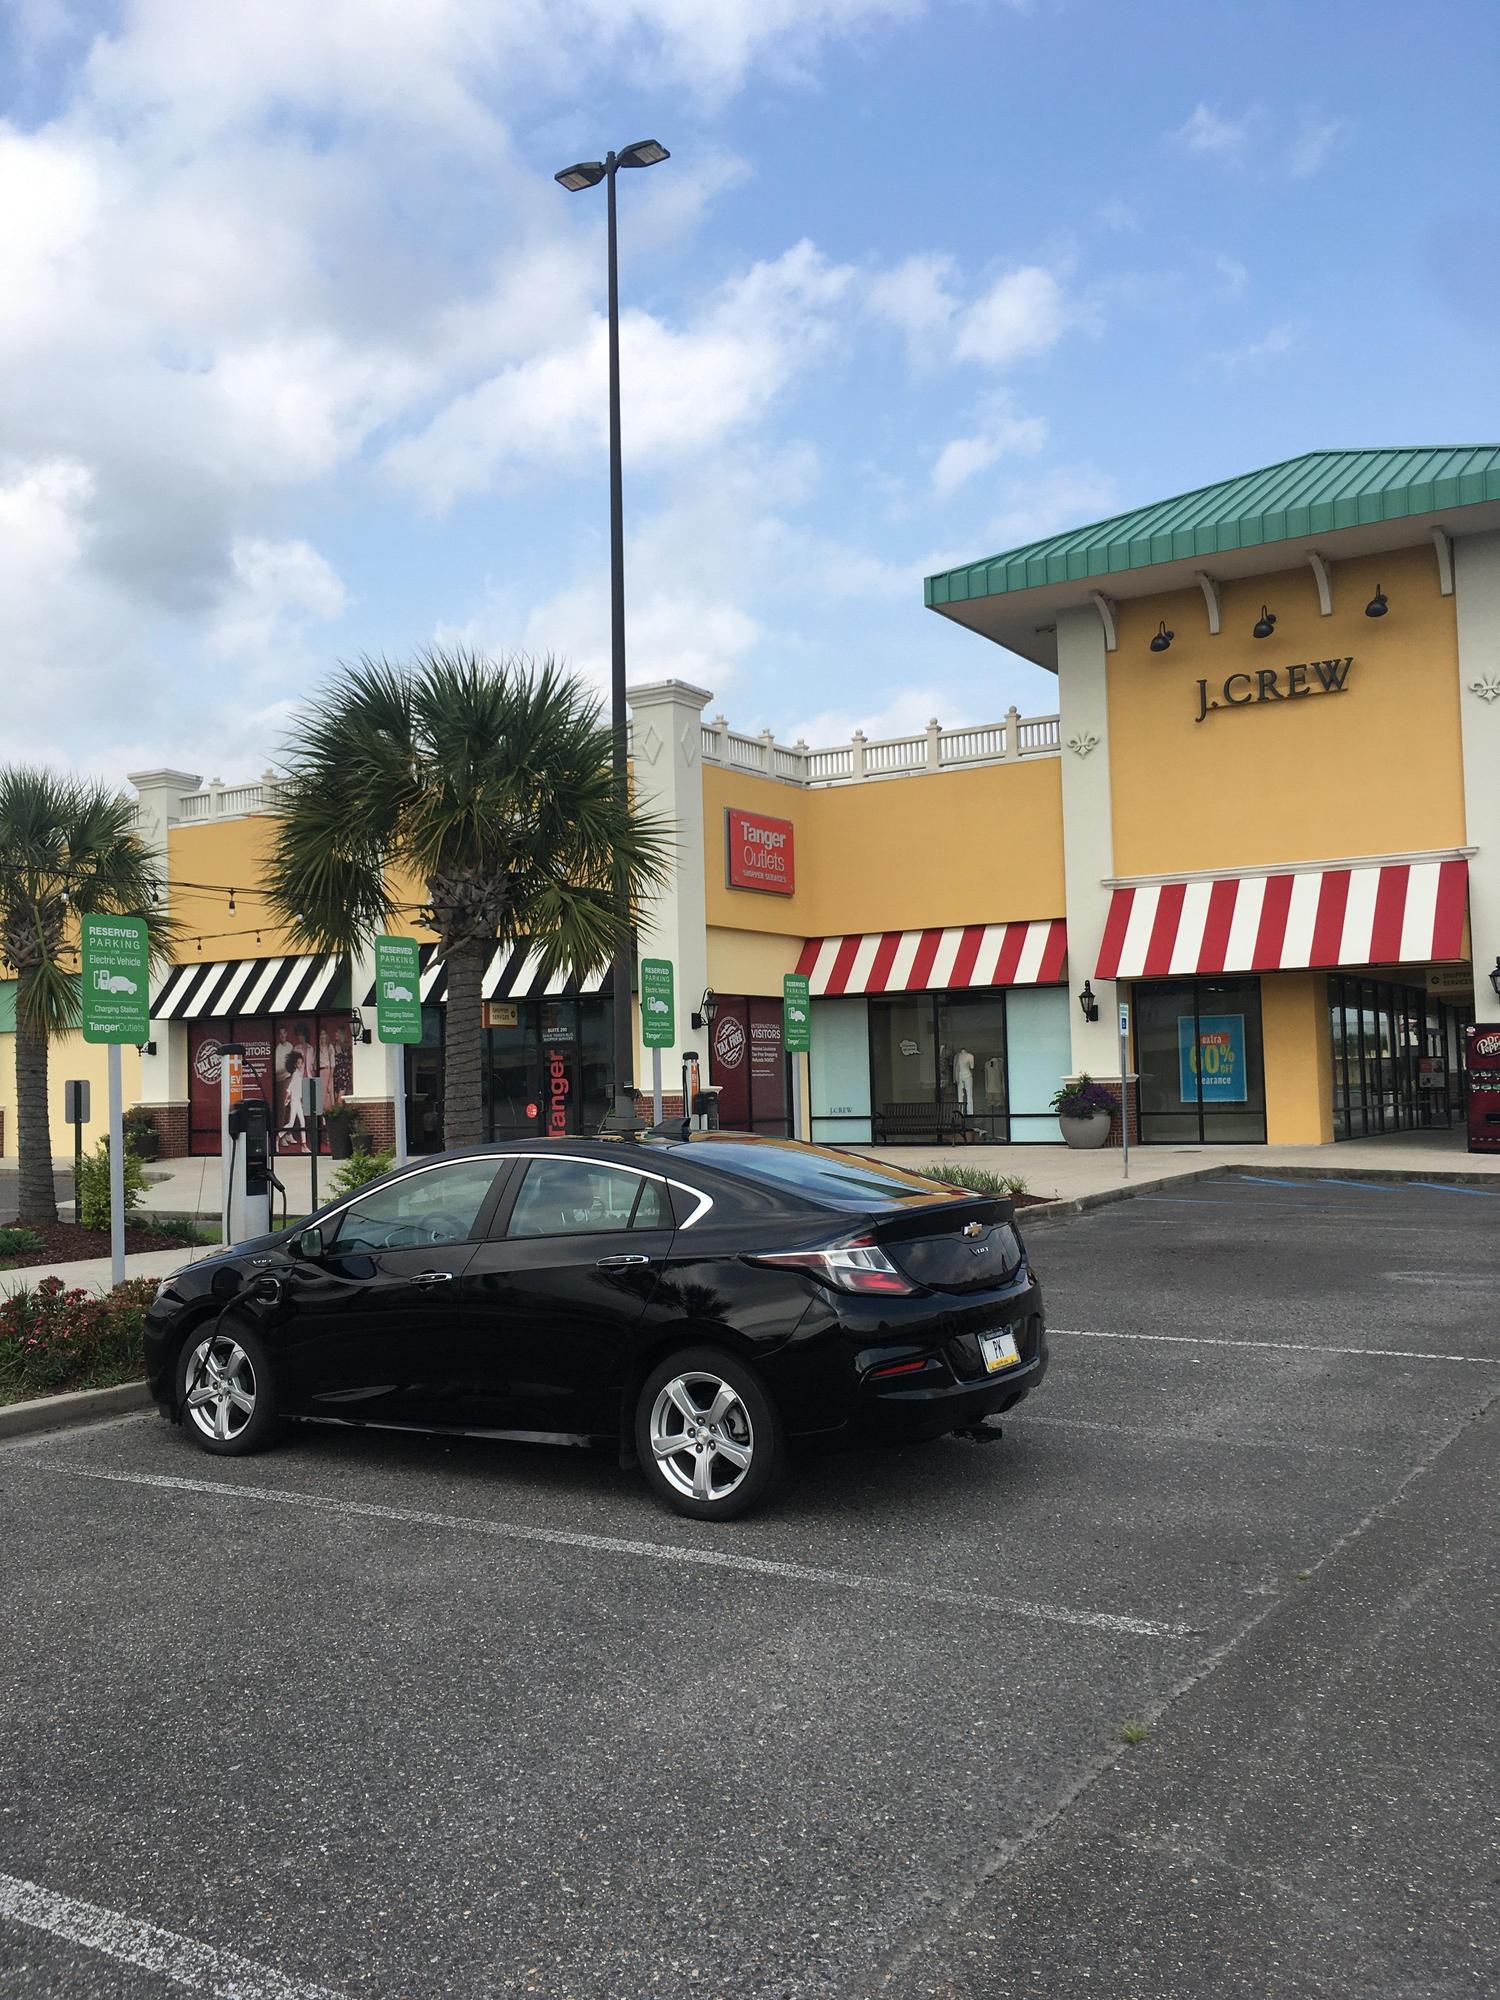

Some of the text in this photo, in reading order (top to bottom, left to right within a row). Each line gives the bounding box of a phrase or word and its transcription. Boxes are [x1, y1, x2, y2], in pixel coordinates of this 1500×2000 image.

[1195, 656, 1354, 723] J.CREW
[740, 820, 786, 850] Tanger
[743, 845, 785, 871] Outlets
[88, 926, 139, 939] RESERVED
[89, 937, 141, 950] PARKING
[379, 945, 413, 955] RESERVED
[89, 954, 141, 967] Electric Vehicle
[380, 954, 415, 965] PARKING
[645, 966, 670, 975] RESERVED
[645, 974, 670, 983] PARKING
[94, 1004, 139, 1014] Charging Station
[89, 1021, 145, 1033] TangerOutlets
[751, 1029, 781, 1039] VISITORS
[1202, 1033, 1222, 1044] extra
[1486, 1035, 1500, 1045] Dr
[716, 1029, 743, 1056] TAX FREE
[1477, 1039, 1500, 1055] Pepp
[197, 1059, 211, 1074] TAX
[1195, 1076, 1231, 1085] cearance
[547, 1049, 570, 1137] Tanger
